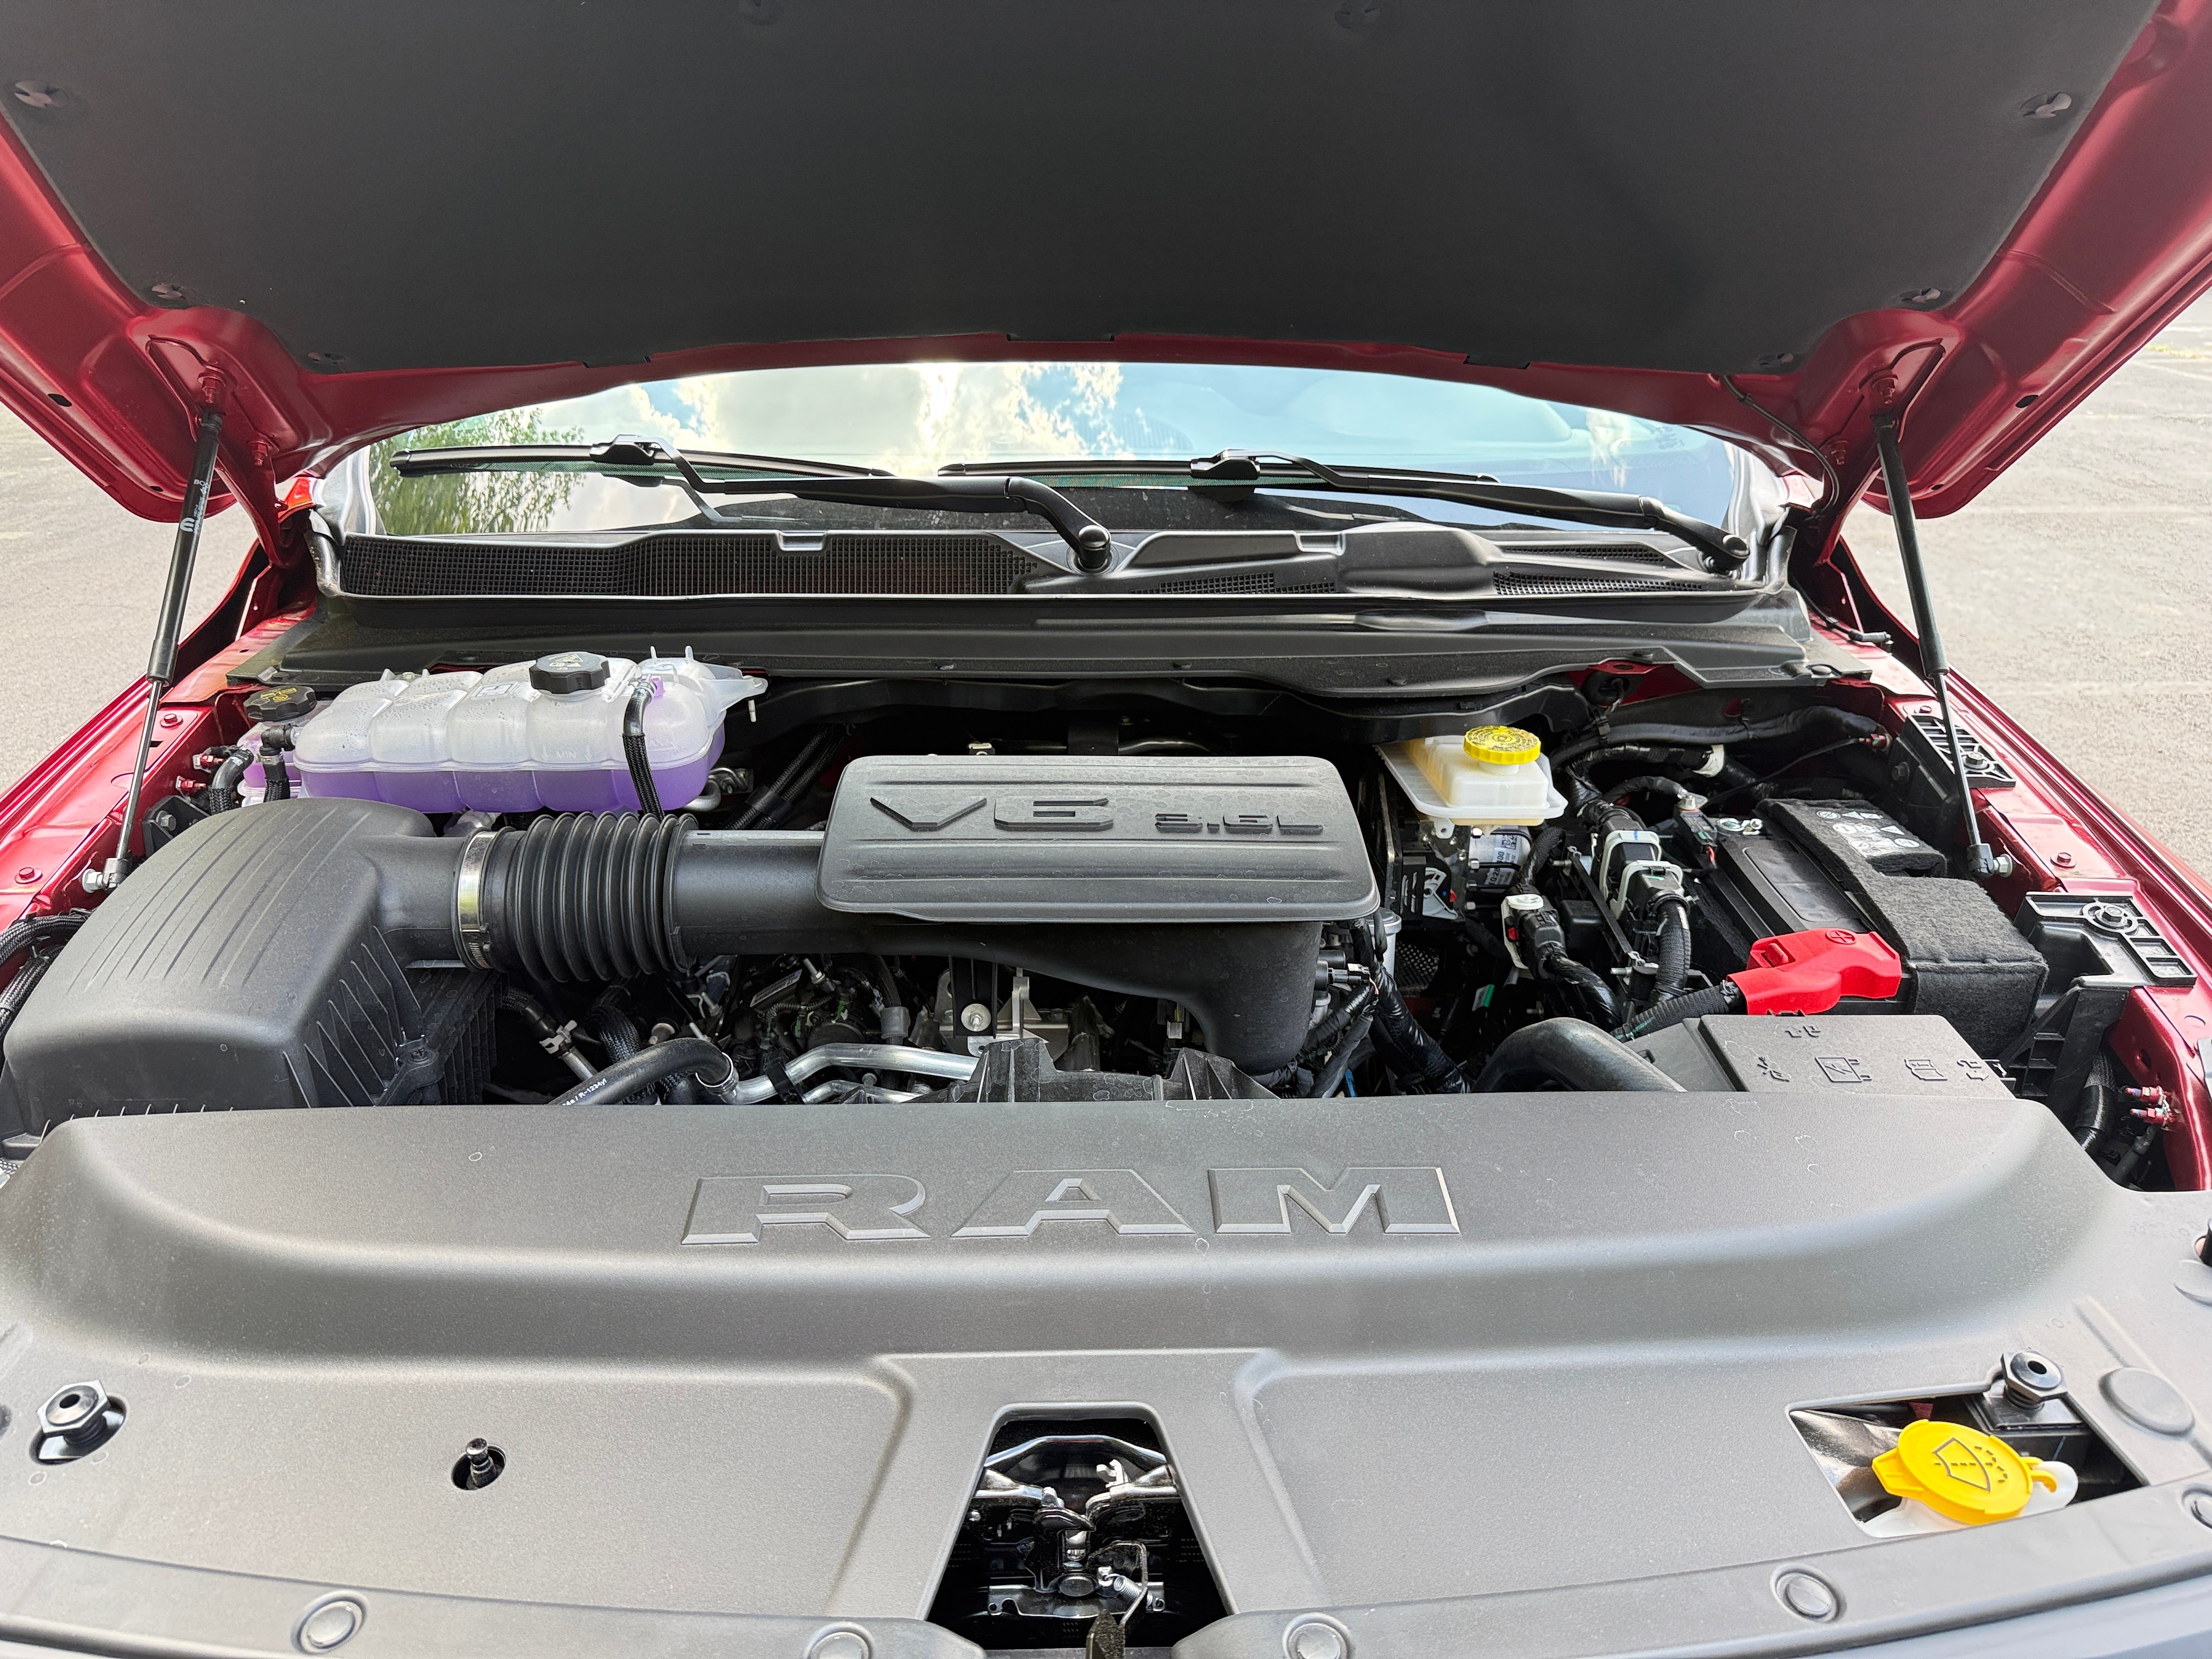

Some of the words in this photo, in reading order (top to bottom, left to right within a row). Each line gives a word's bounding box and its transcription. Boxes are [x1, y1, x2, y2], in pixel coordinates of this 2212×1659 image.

[556, 750, 577, 759] MIN
[869, 795, 1115, 833] V6
[1154, 812, 1324, 835] 3.6L
[680, 1167, 1461, 1245] RAM
